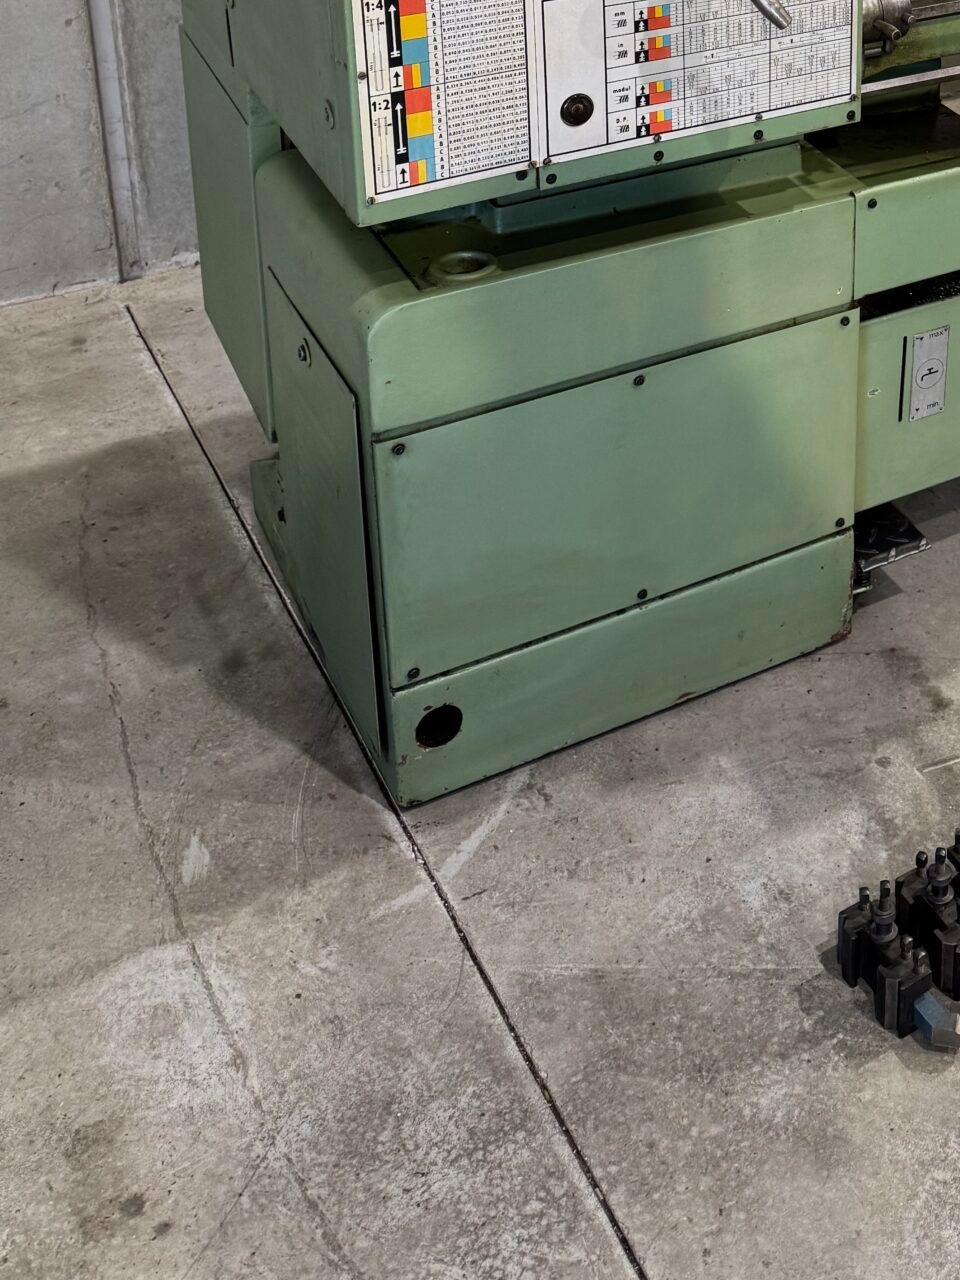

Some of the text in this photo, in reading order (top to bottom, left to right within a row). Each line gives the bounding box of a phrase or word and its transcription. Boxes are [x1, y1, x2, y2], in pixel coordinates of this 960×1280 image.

[365, 0, 384, 12] 1:4
[612, 86, 631, 94] modul
[371, 99, 391, 113] 1:2
[929, 331, 943, 339] max
